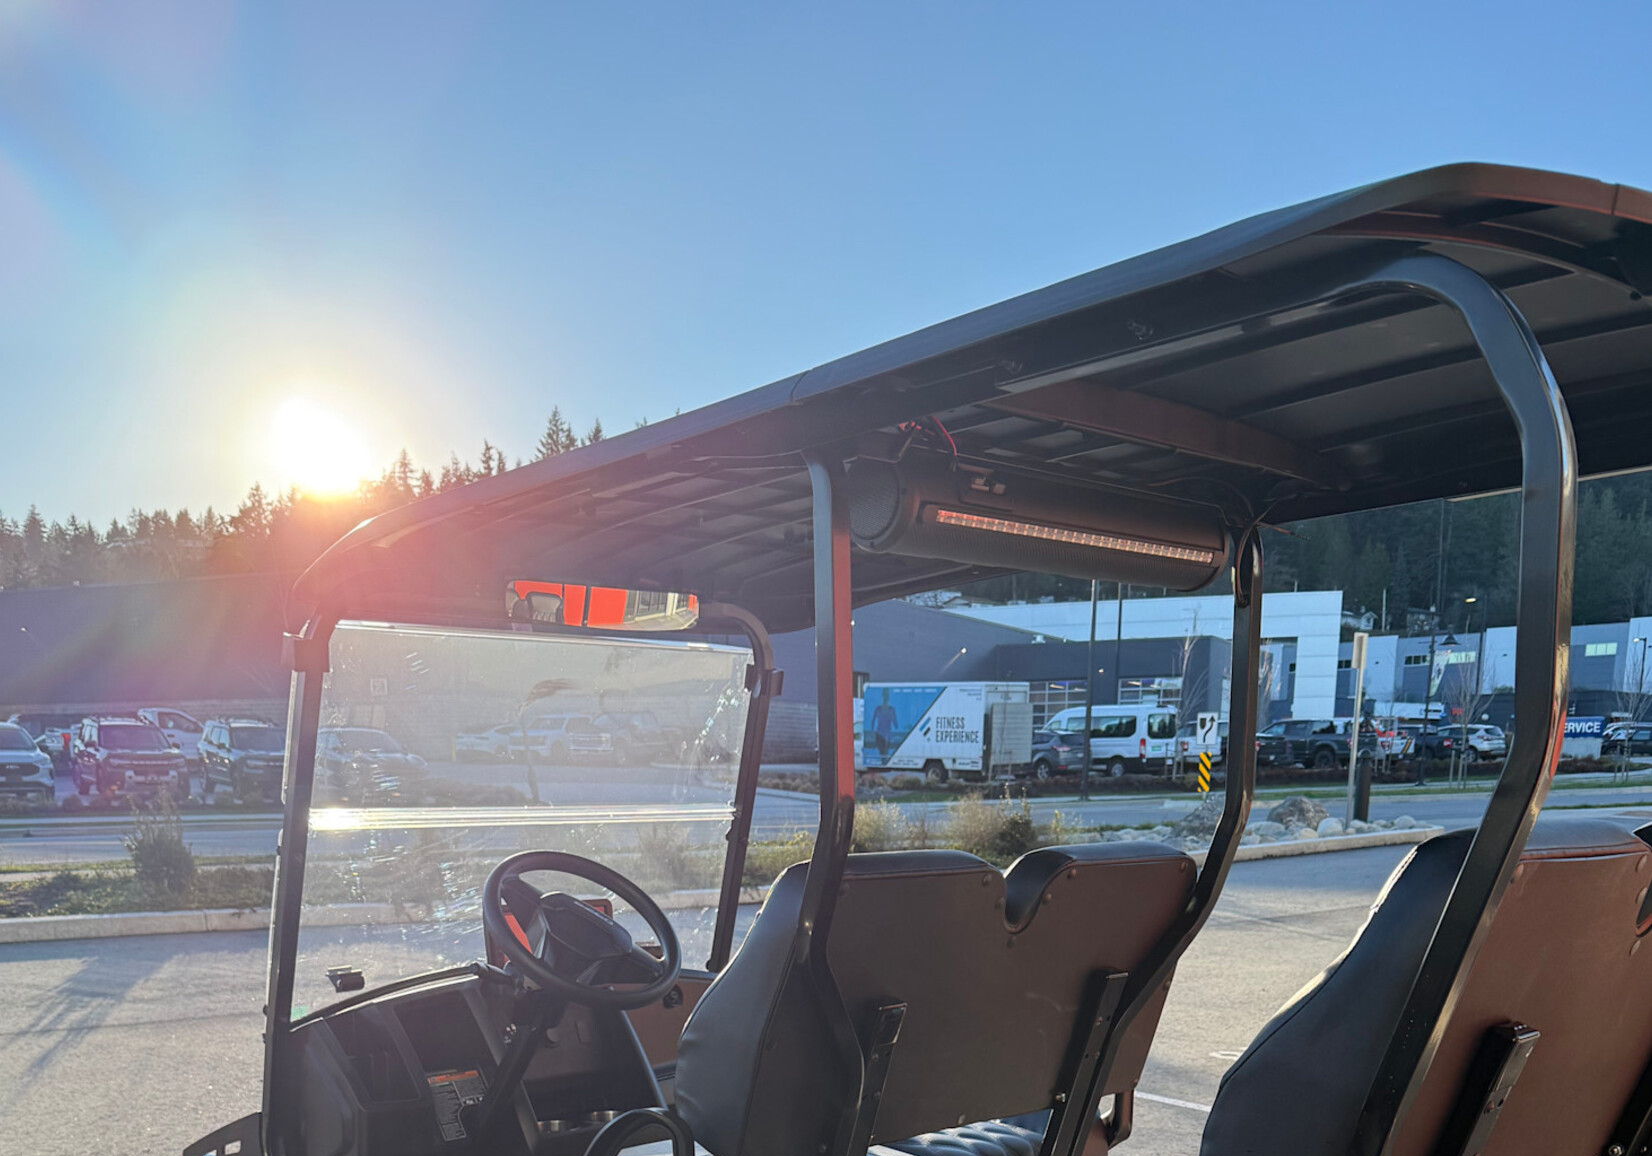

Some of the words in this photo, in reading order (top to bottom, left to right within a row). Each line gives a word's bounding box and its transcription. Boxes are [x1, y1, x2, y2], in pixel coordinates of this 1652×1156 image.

[935, 716, 965, 729] FITNESS
[1564, 721, 1601, 733] ERVICE
[935, 730, 979, 743] EXPERIENCE
